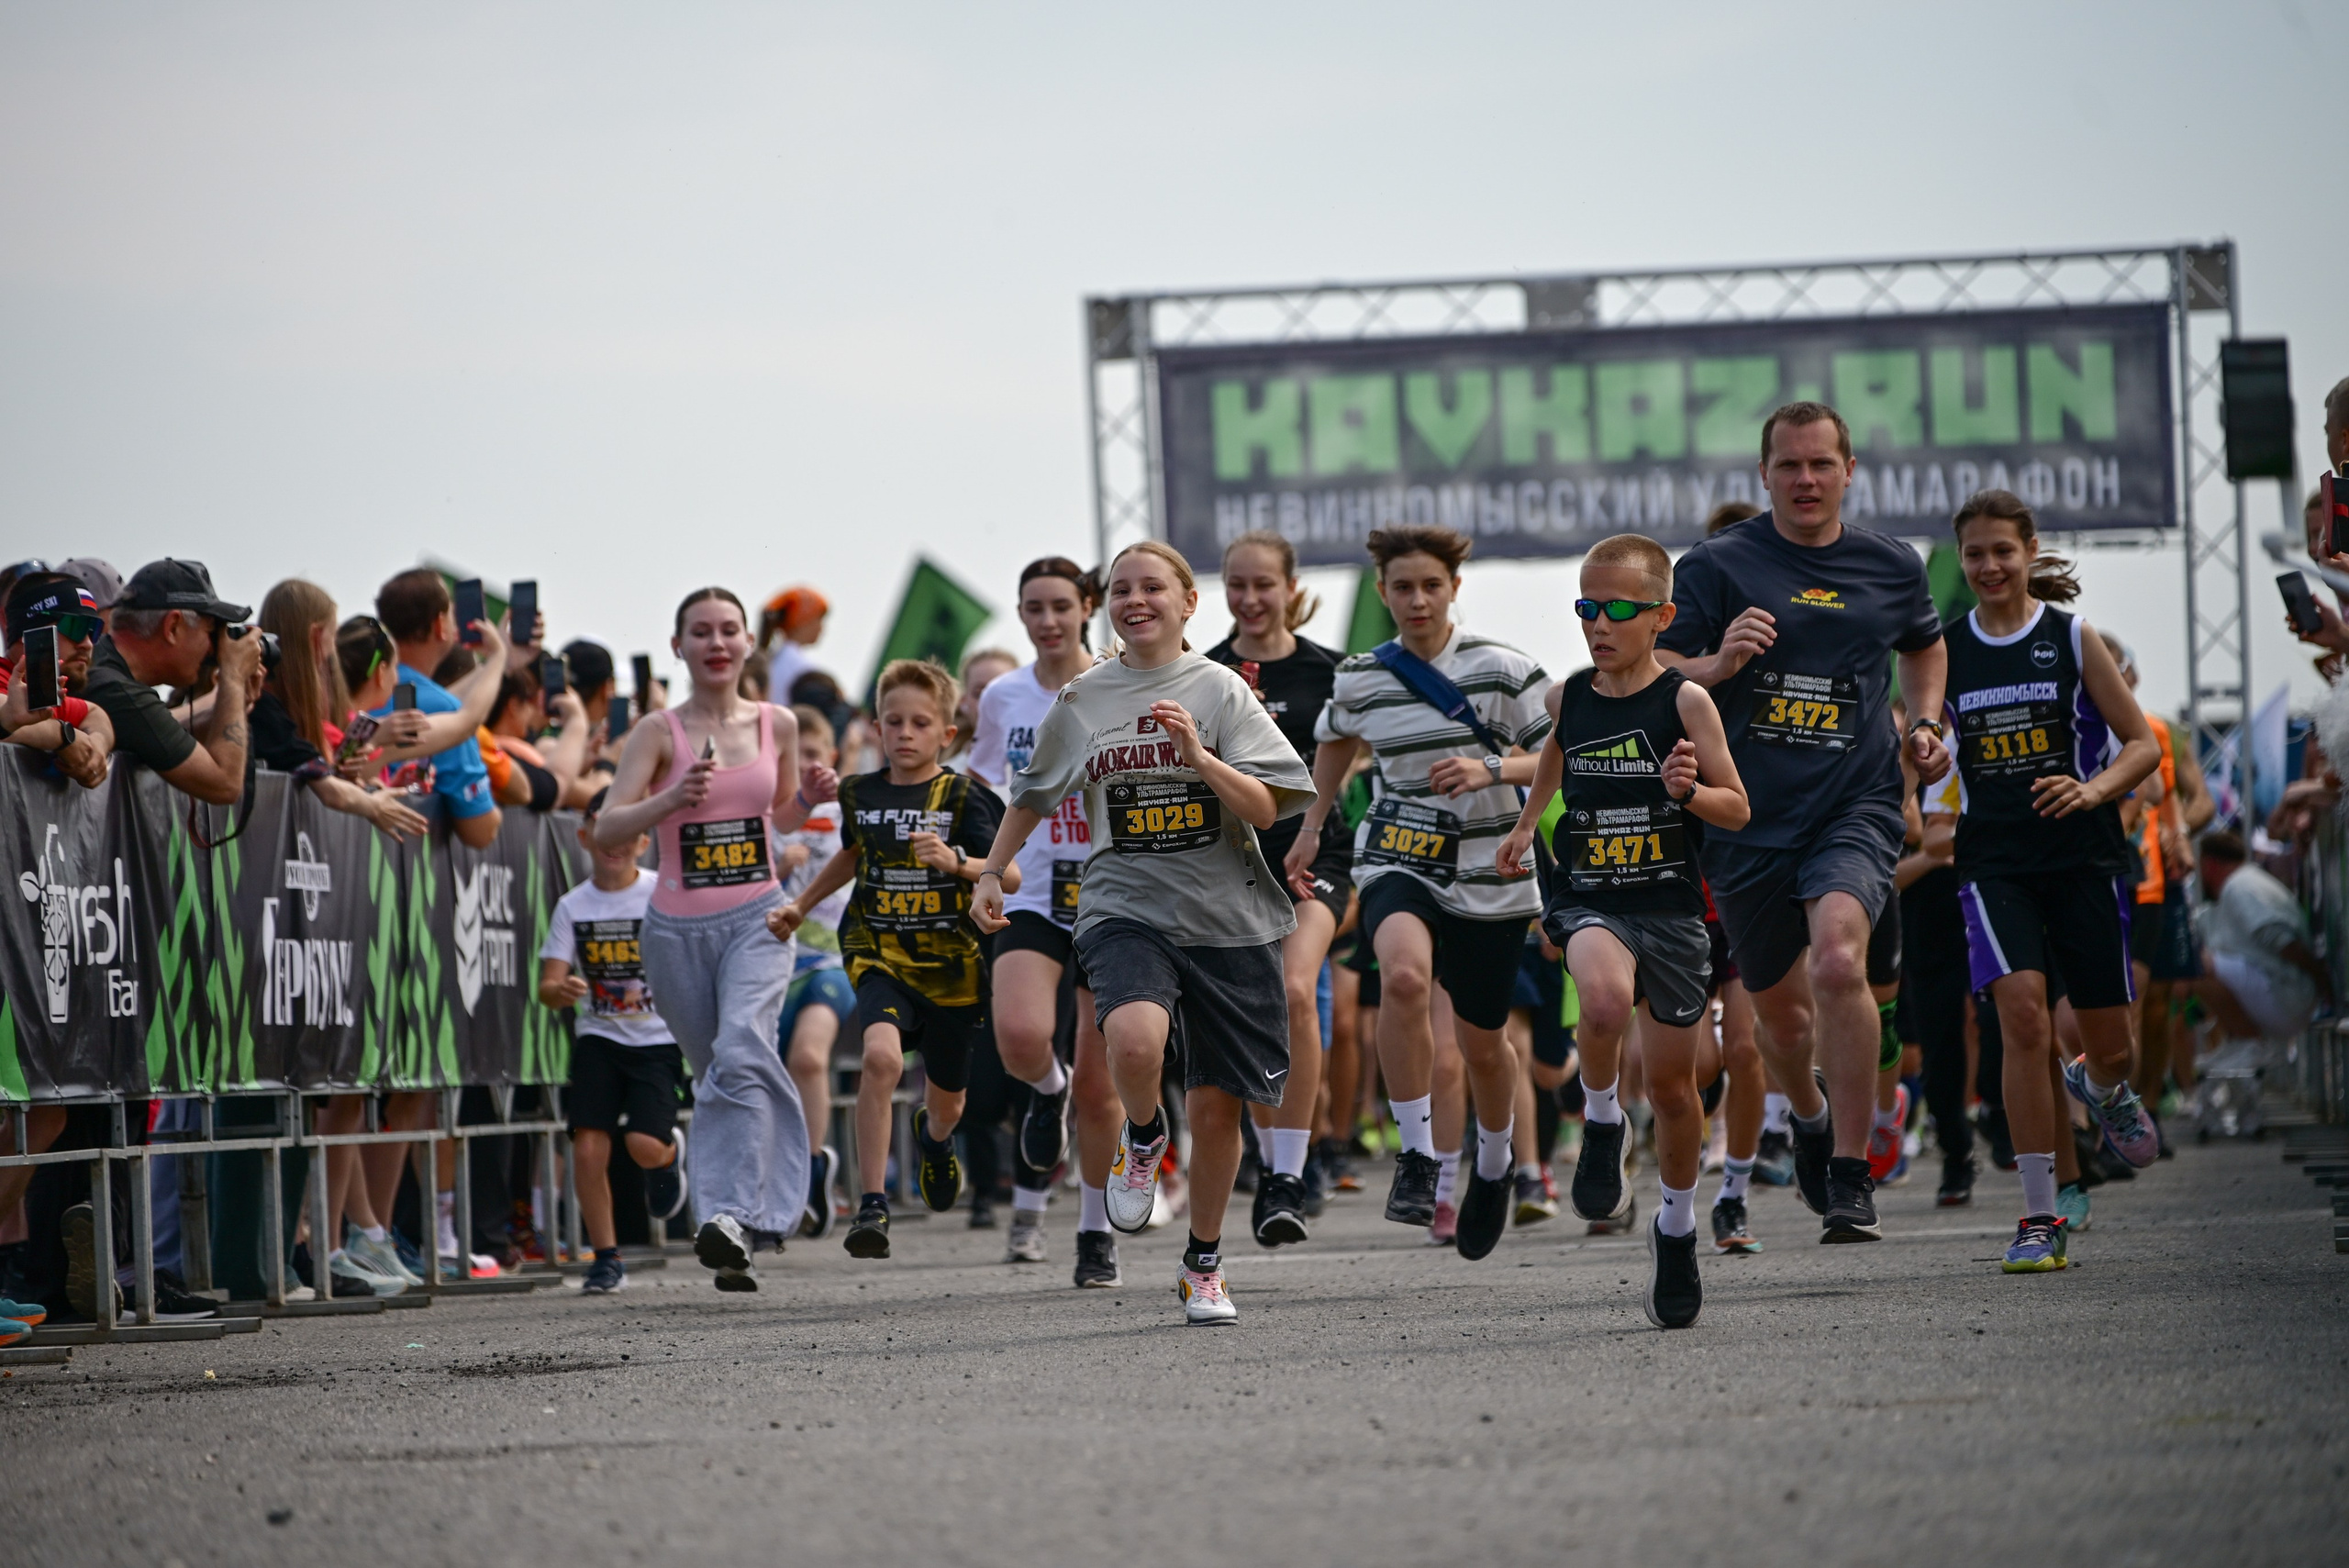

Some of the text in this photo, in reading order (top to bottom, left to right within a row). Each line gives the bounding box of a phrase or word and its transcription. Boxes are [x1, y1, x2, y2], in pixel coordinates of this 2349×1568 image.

[44, 595, 58, 608] SKI
[1791, 596, 1845, 609] RUN SLOWER
[1959, 682, 2057, 713] НЕВИННОМЫССК
[1769, 697, 1839, 729] 3472
[1980, 728, 2049, 760] 3118
[1568, 758, 1654, 773] Without Limits
[1137, 788, 1188, 797] УЛЬТРАМАРАФОН
[854, 809, 953, 825] THE FUTURE
[1126, 804, 1204, 833] 3029
[1597, 815, 1650, 825] УЛЬТРАМАРАФОН
[896, 824, 909, 840] IS
[1380, 825, 1445, 858] 3027
[695, 841, 757, 869] 3482
[1588, 834, 1664, 865] 3471
[876, 891, 941, 915] 3479
